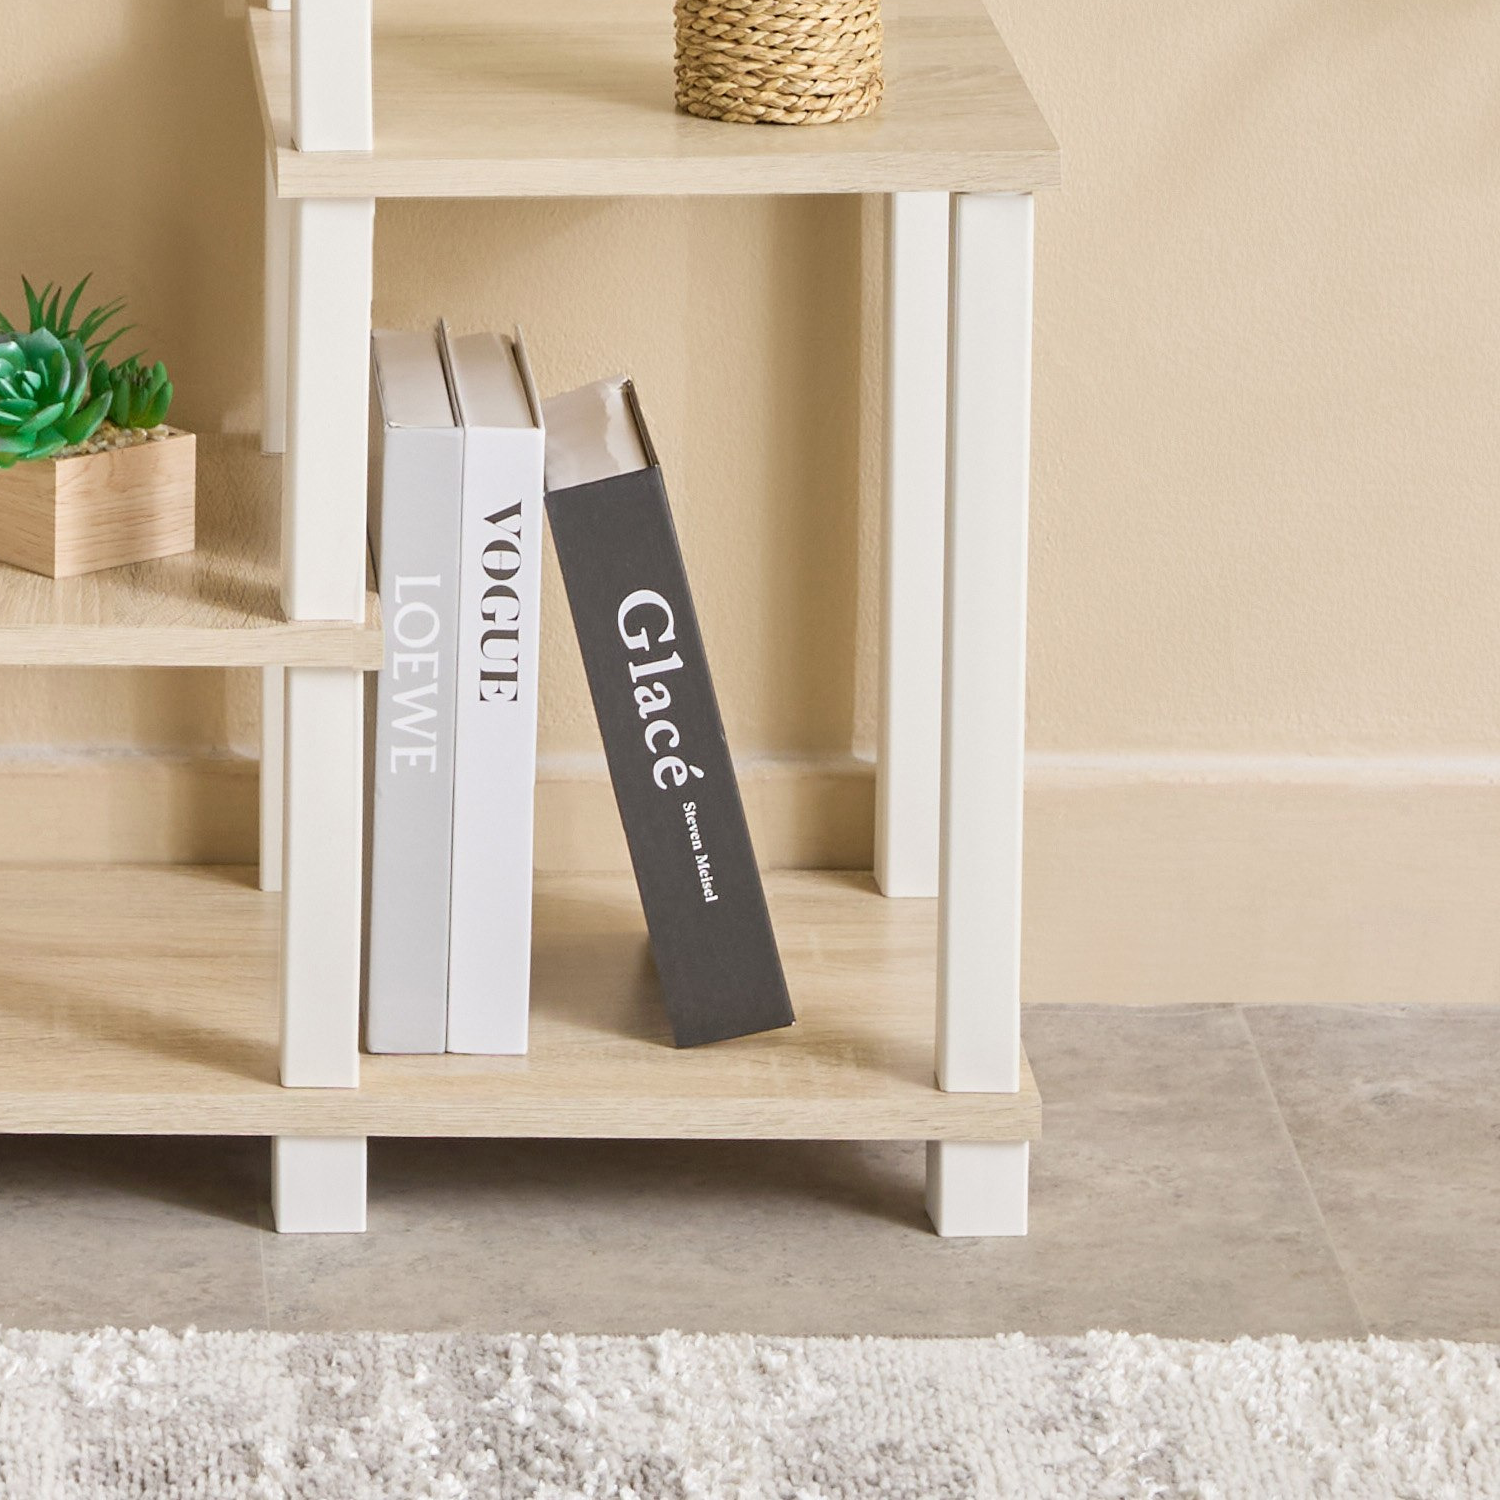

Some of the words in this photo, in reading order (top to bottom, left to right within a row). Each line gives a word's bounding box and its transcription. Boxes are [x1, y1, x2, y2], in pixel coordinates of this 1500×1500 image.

[389, 573, 442, 775] LOEWE
[479, 499, 523, 702] VOGUE
[616, 588, 705, 791] Glacé
[682, 801, 703, 851] Steven
[695, 854, 719, 903] Meisel
